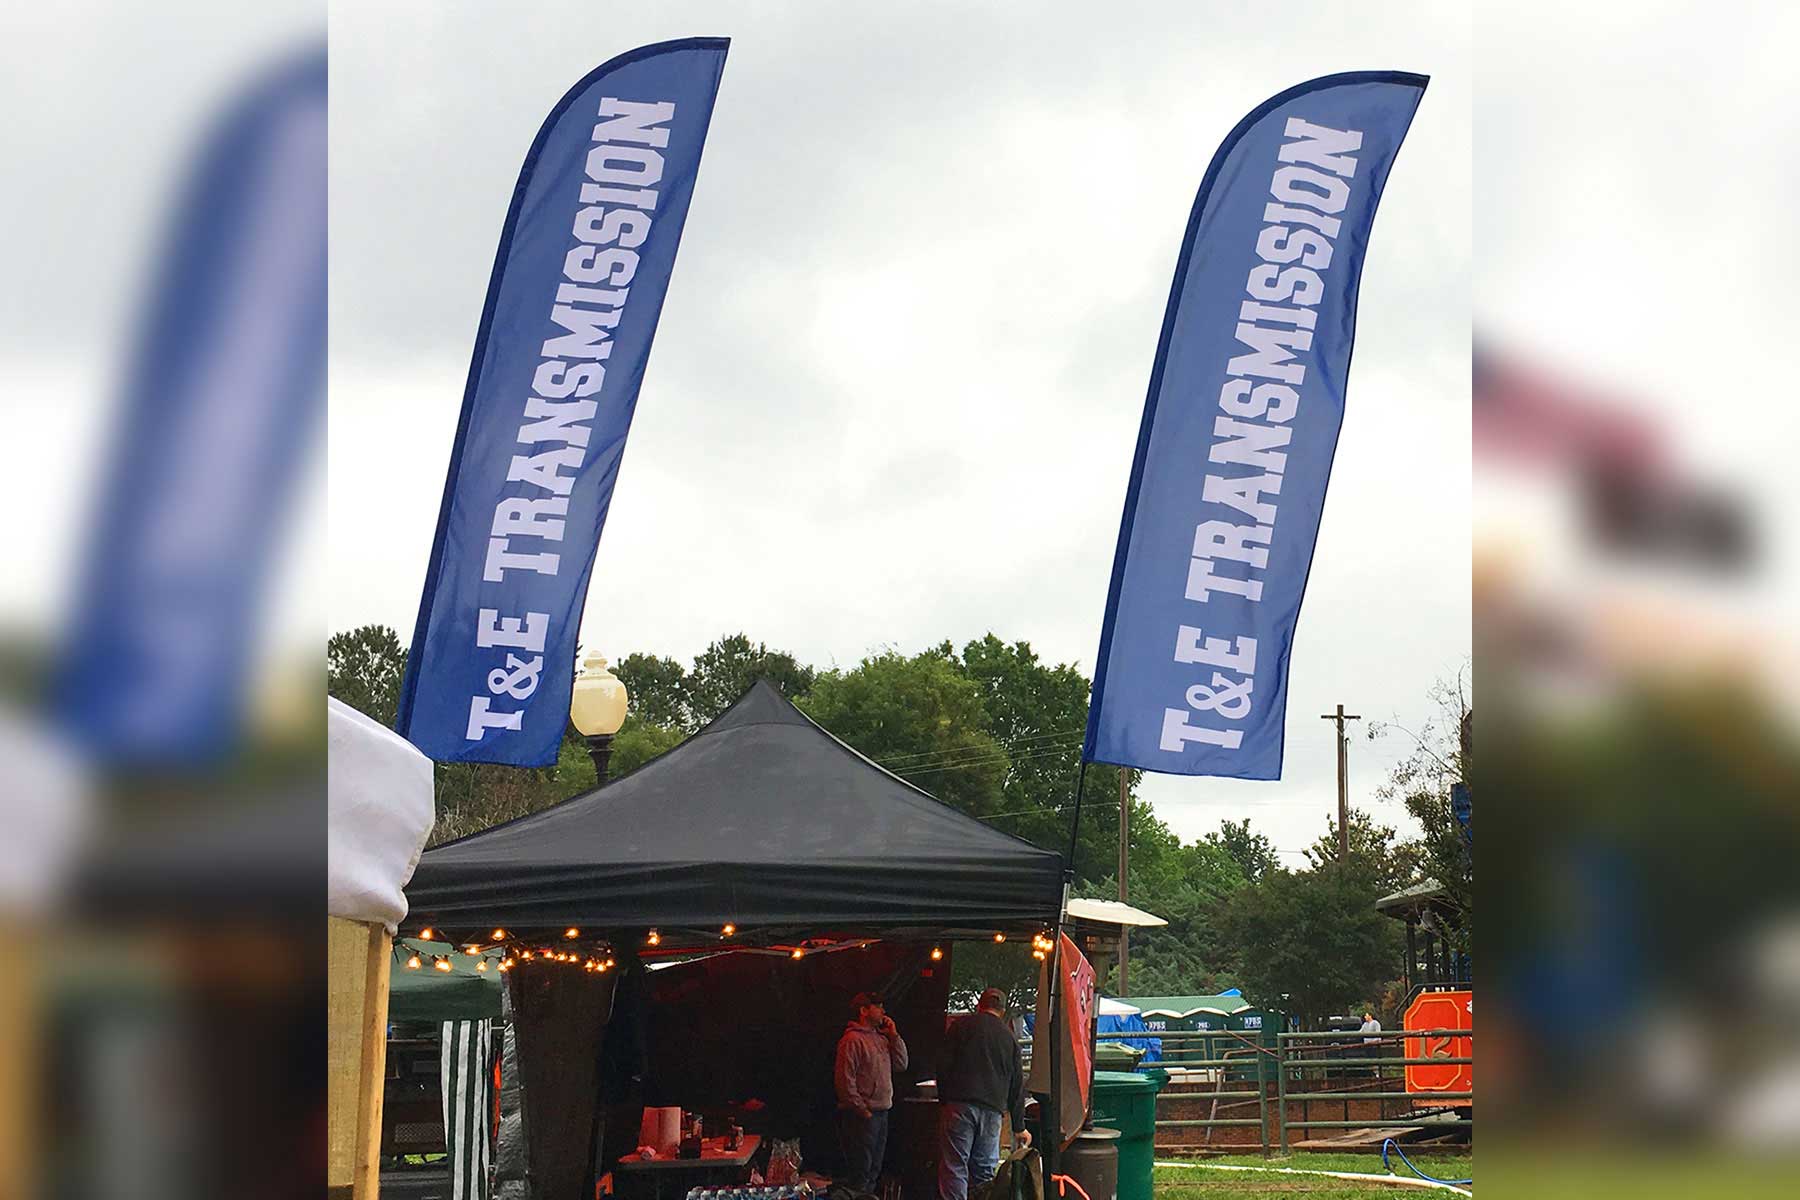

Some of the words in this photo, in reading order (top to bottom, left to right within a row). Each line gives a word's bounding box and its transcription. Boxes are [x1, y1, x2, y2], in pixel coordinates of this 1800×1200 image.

[483, 97, 676, 582] TRANSMISSION
[1185, 117, 1364, 603] TRANSMISSION
[466, 609, 550, 741] T&E
[1160, 625, 1257, 753] T&E
[1418, 1027, 1453, 1059] 12
